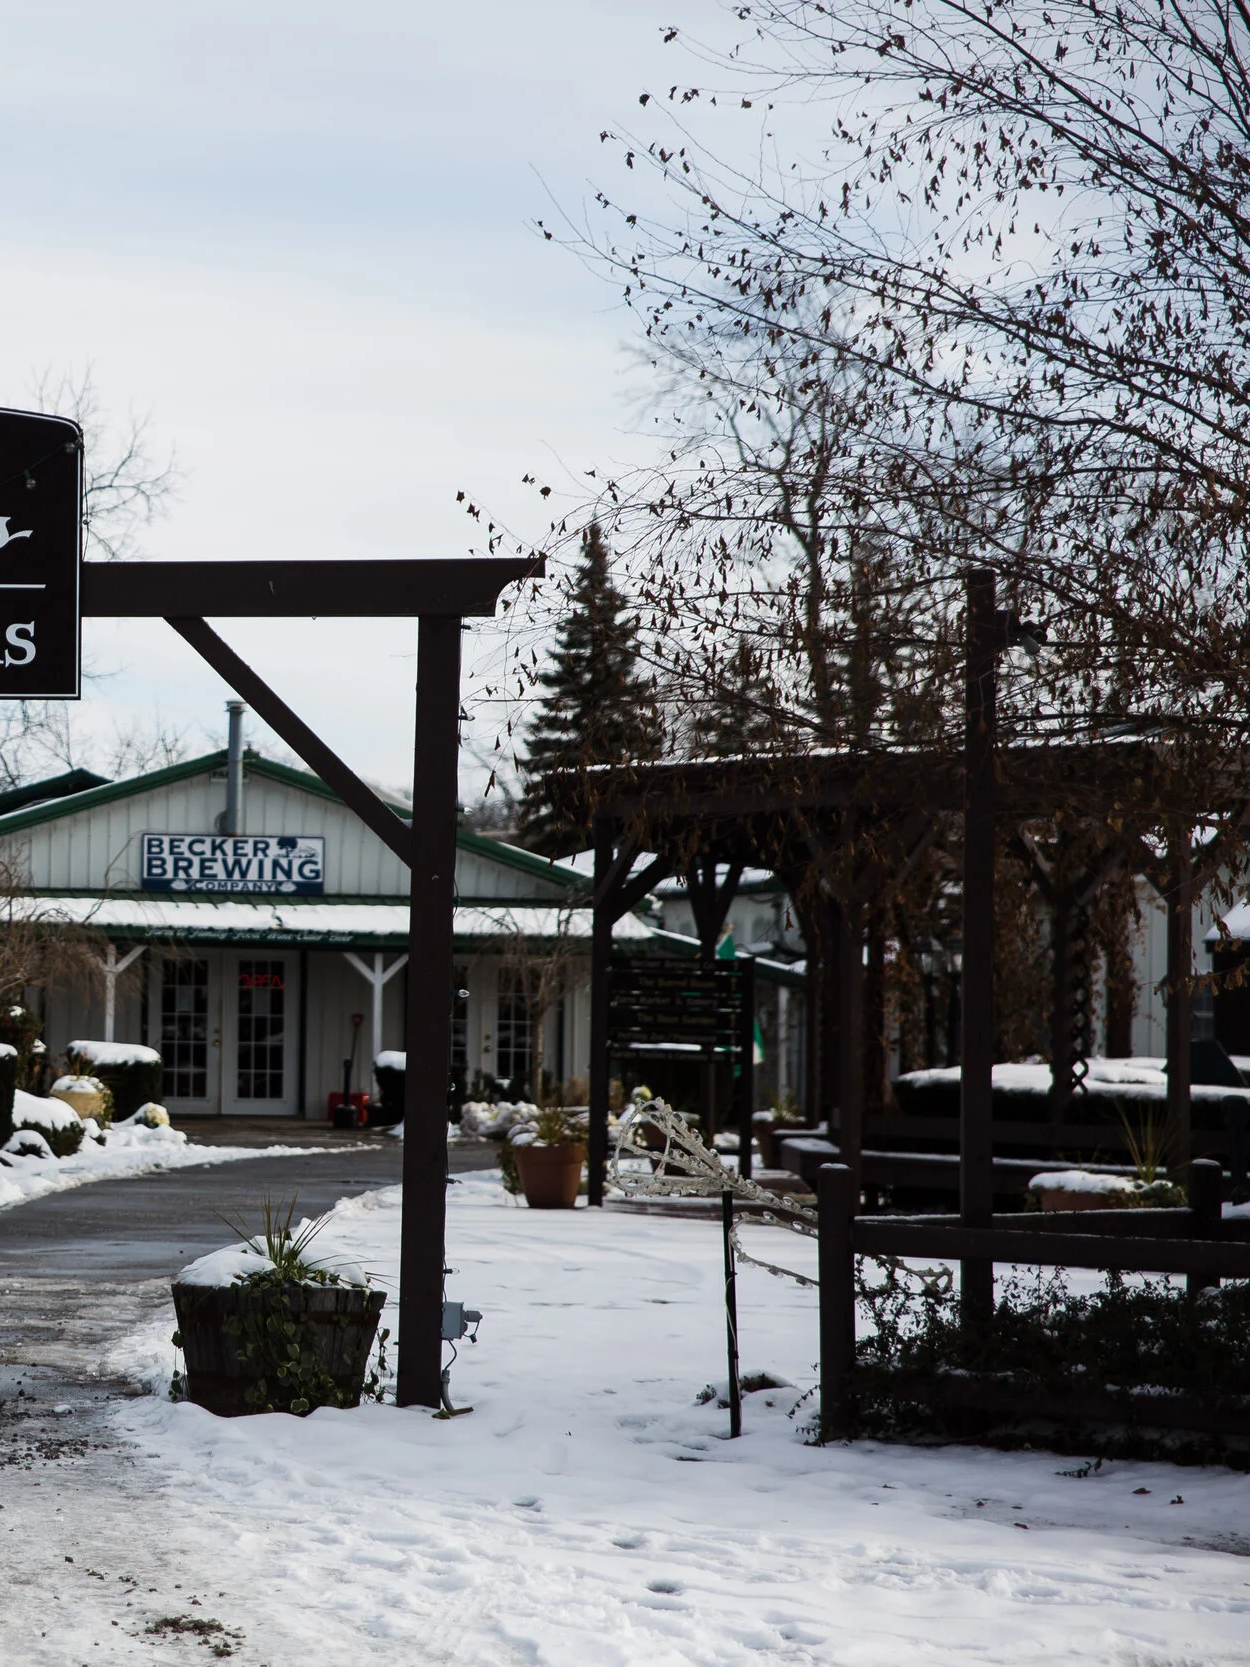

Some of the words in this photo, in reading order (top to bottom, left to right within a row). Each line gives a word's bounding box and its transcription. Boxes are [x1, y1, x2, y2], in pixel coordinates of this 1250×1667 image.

[146, 837, 270, 858] BECKER
[146, 856, 322, 881] BREWING
[192, 880, 276, 891] COMPANY
